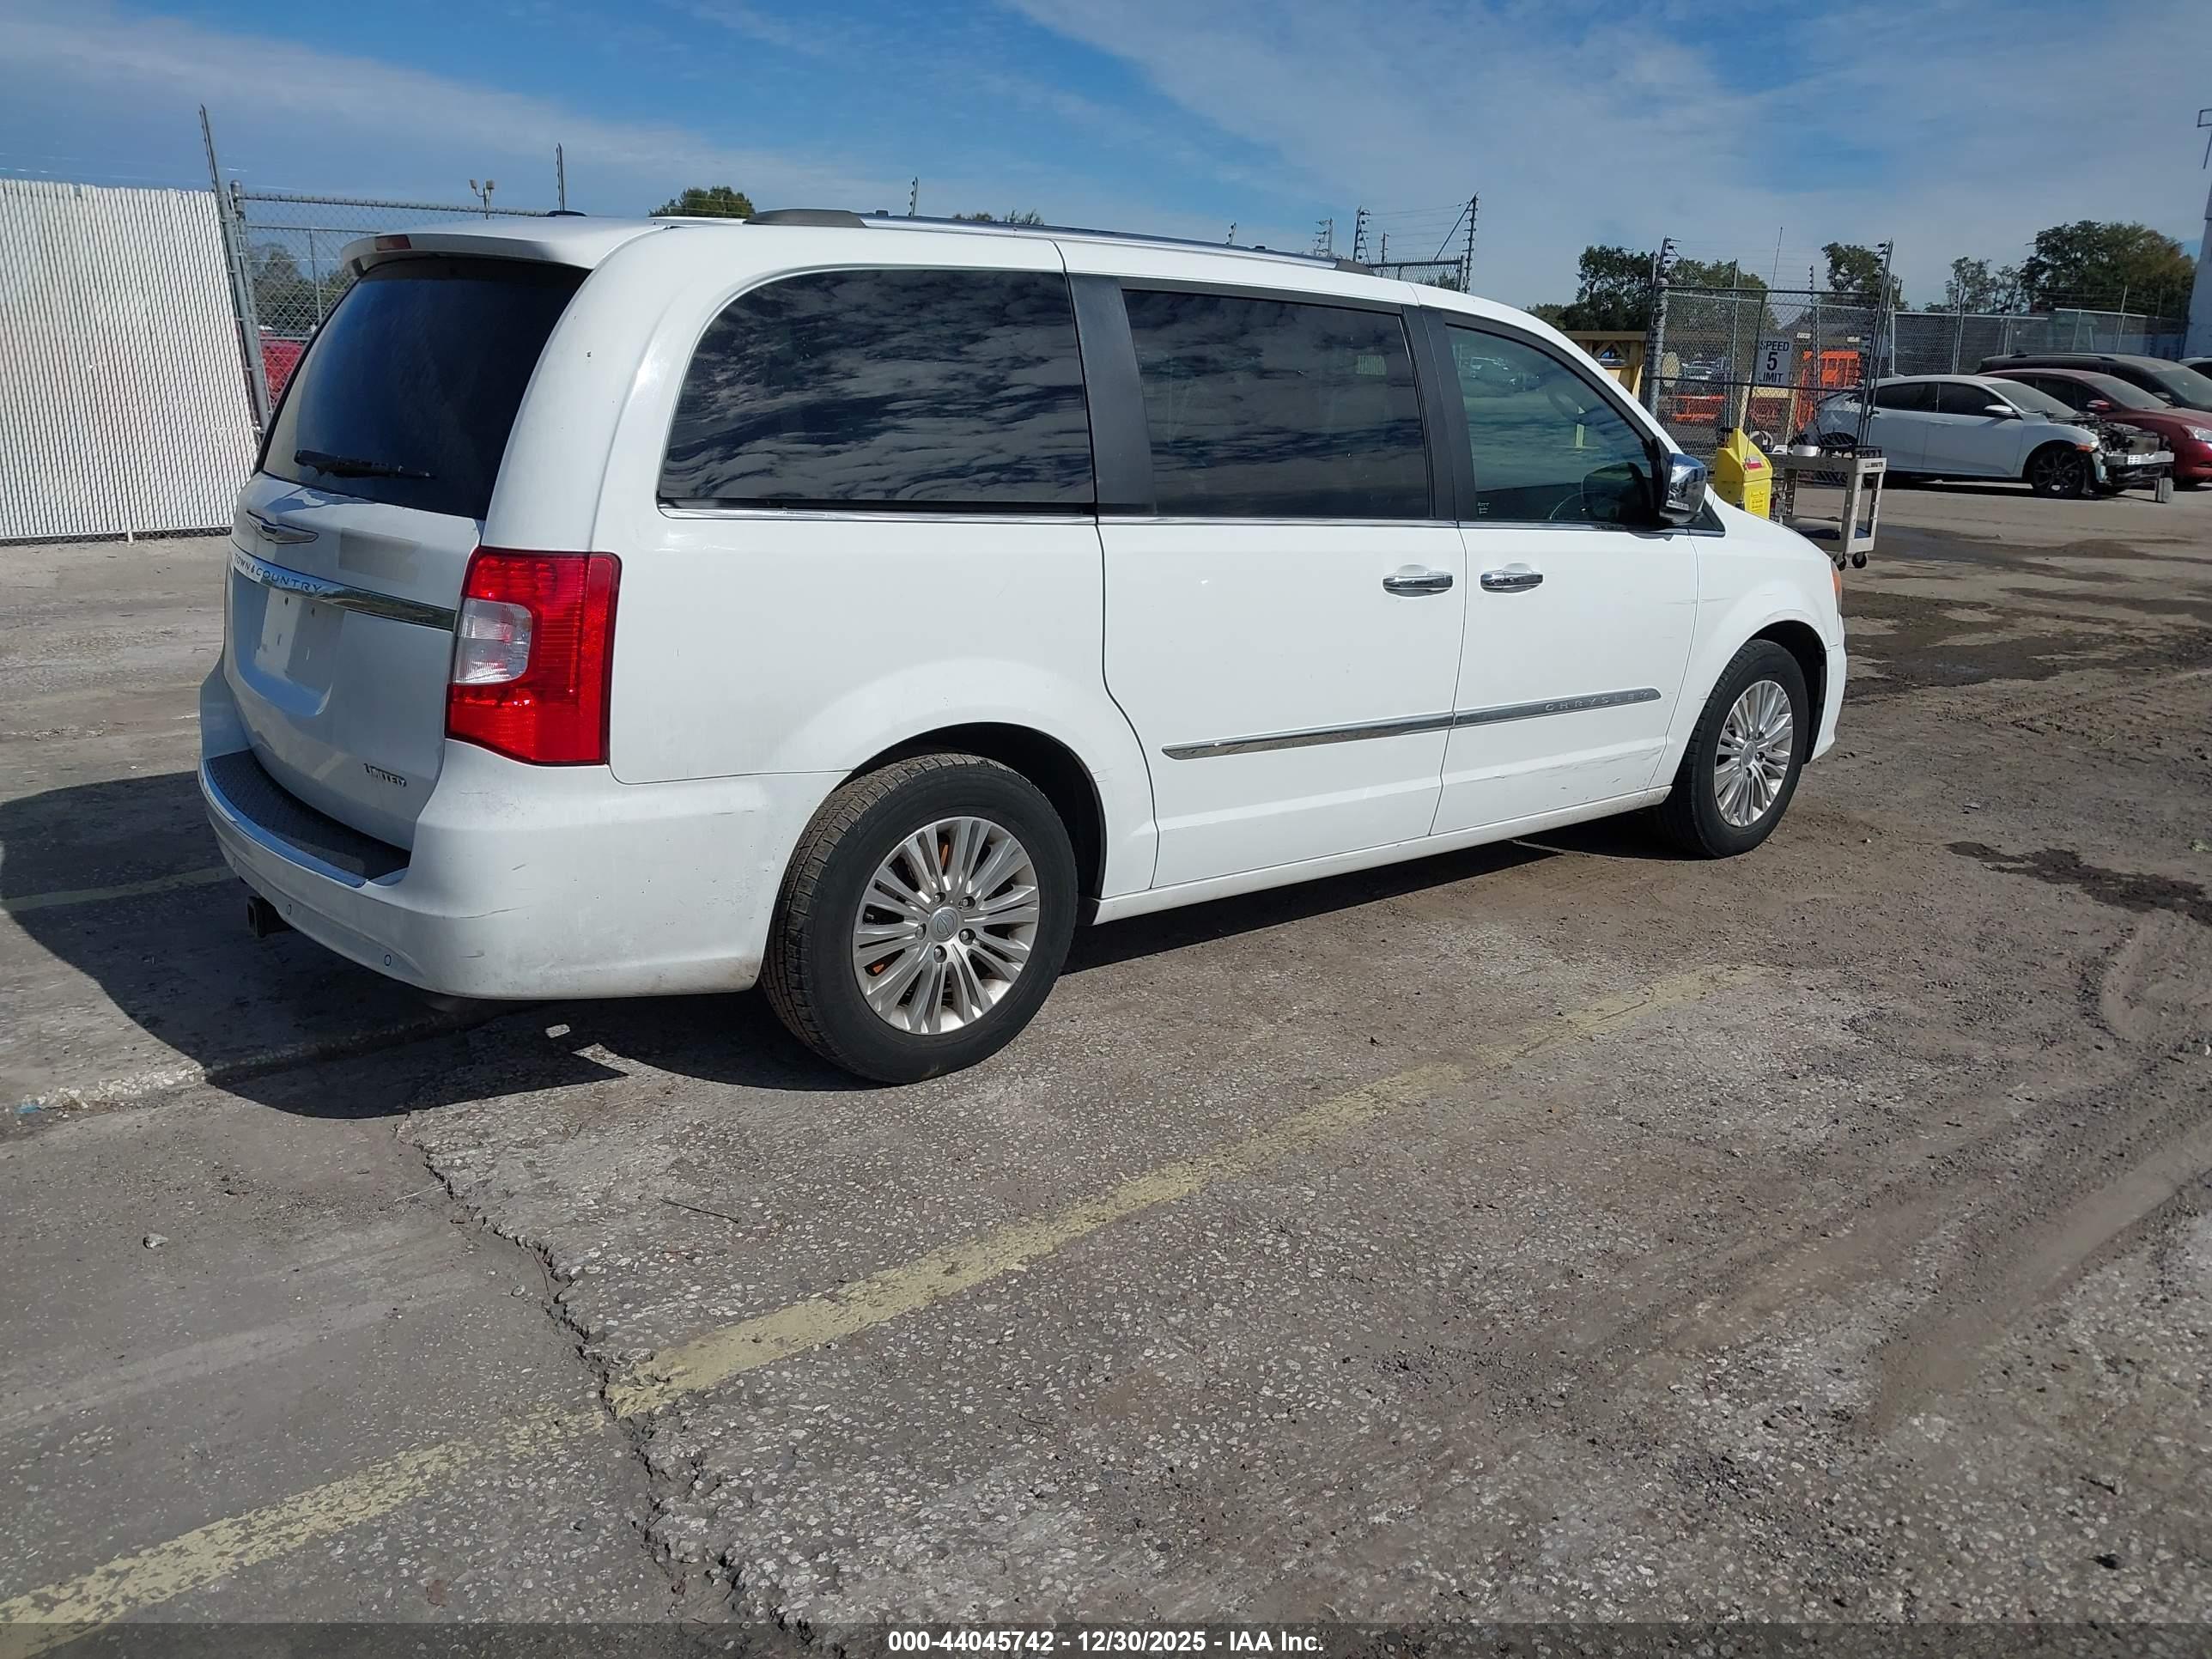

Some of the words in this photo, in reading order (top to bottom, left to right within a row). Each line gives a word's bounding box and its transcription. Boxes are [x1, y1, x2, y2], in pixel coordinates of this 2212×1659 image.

[1759, 340, 1790, 351] SPEED
[1766, 351, 1778, 370] 5
[1758, 372, 1784, 383] LIMIT
[1545, 691, 1649, 711] CHRYSLER
